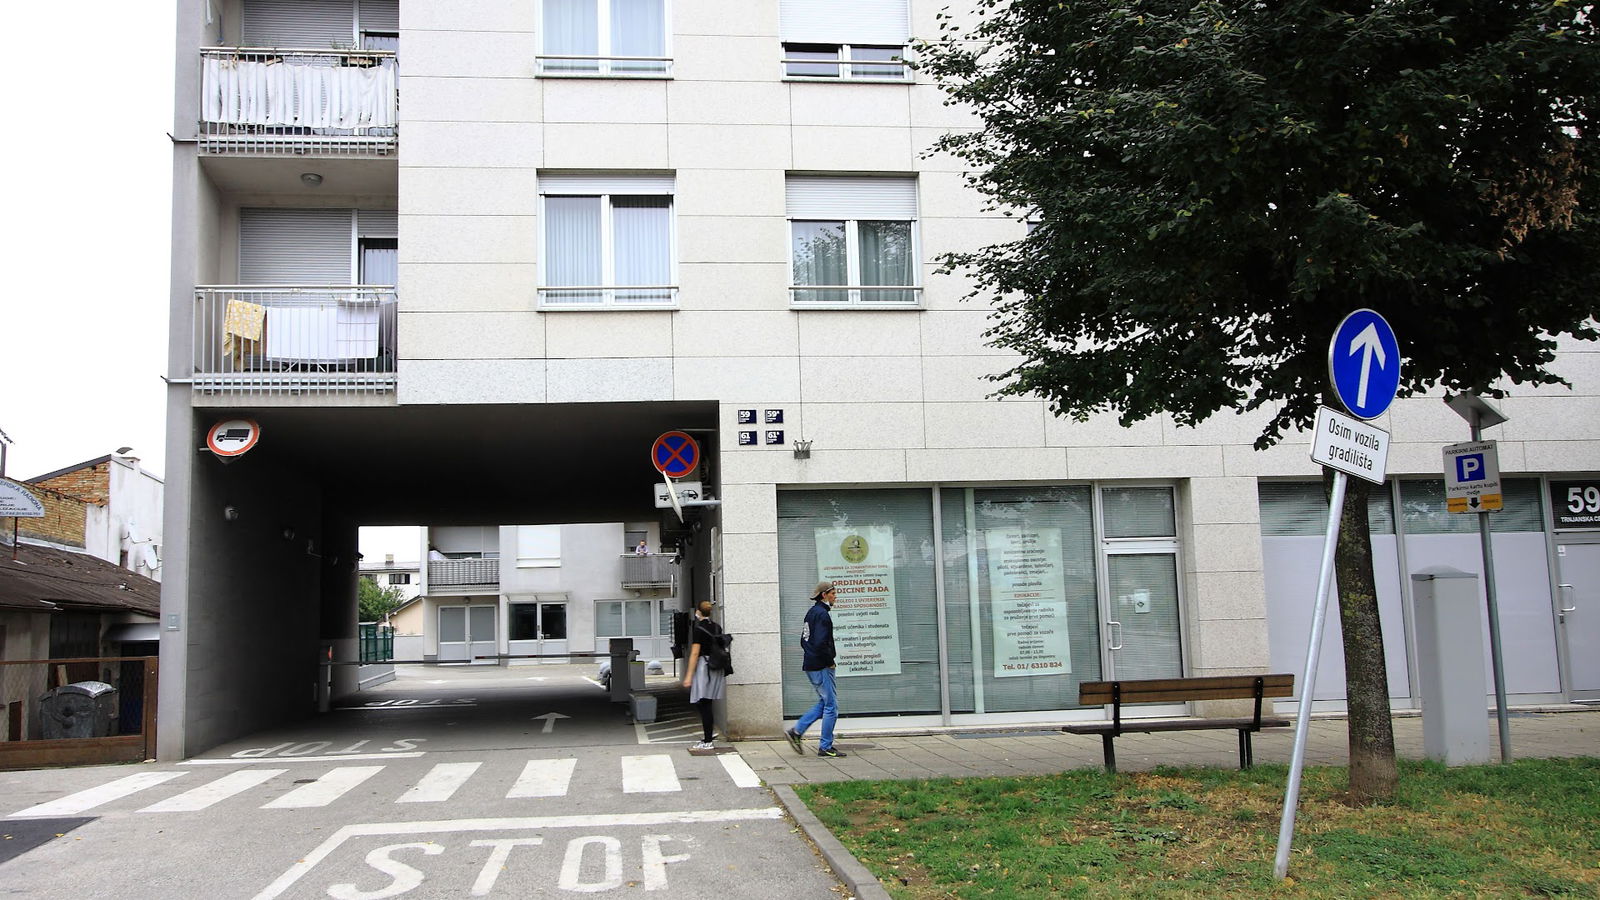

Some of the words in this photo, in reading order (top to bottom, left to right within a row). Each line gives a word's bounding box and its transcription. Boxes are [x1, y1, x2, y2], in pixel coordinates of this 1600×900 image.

[1328, 418, 1352, 440] Osim
[1354, 431, 1380, 451] vozila
[1328, 444, 1374, 471] gradilišta
[1462, 458, 1480, 480] P
[1568, 486, 1600, 513] 59
[832, 578, 882, 586] ORDINACIJA
[231, 738, 428, 758] STOP
